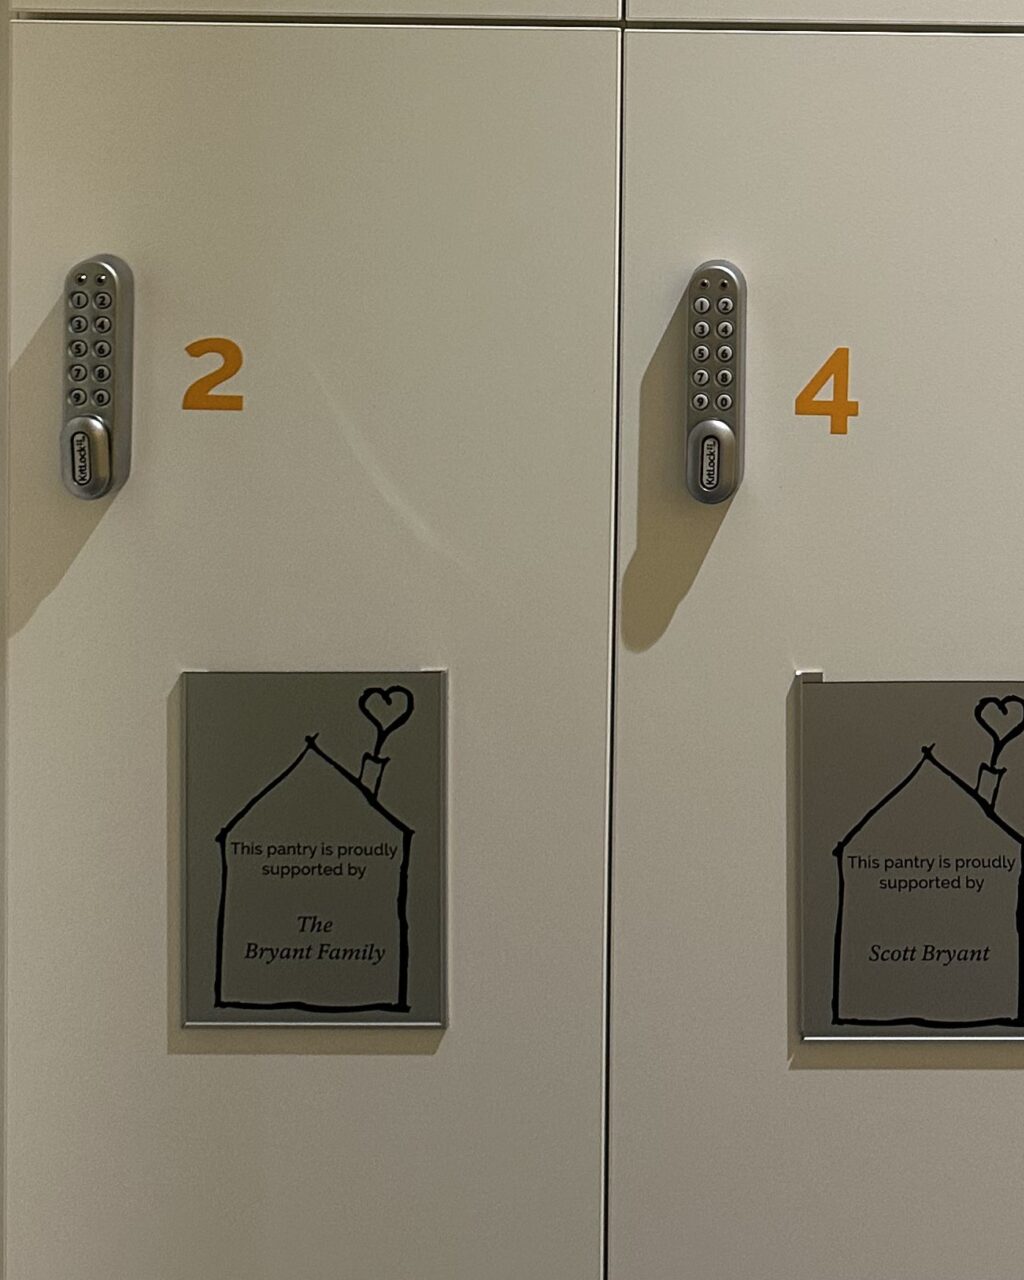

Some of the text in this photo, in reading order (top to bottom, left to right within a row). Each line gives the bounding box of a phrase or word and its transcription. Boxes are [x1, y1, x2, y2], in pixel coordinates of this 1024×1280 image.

[76, 296, 106, 306] 1 2
[700, 301, 729, 311] 1 2
[75, 320, 105, 330] 3 4
[698, 325, 729, 335] 3 4
[74, 344, 105, 355] 5 6
[697, 348, 729, 359] 5 6
[75, 369, 105, 379] 7 8
[183, 338, 243, 411] 2
[697, 373, 728, 383] 7 8
[796, 348, 858, 434] 4
[73, 393, 104, 404] 9 0
[697, 397, 728, 408] 9 0
[231, 842, 398, 860] This pantry is proudly
[848, 855, 1016, 871] This pantry is proudly
[262, 863, 367, 880] supported by
[879, 876, 985, 892] supported by
[297, 916, 333, 933] The
[244, 942, 386, 966] Bryant Family
[868, 944, 991, 966] Scott Bryant
